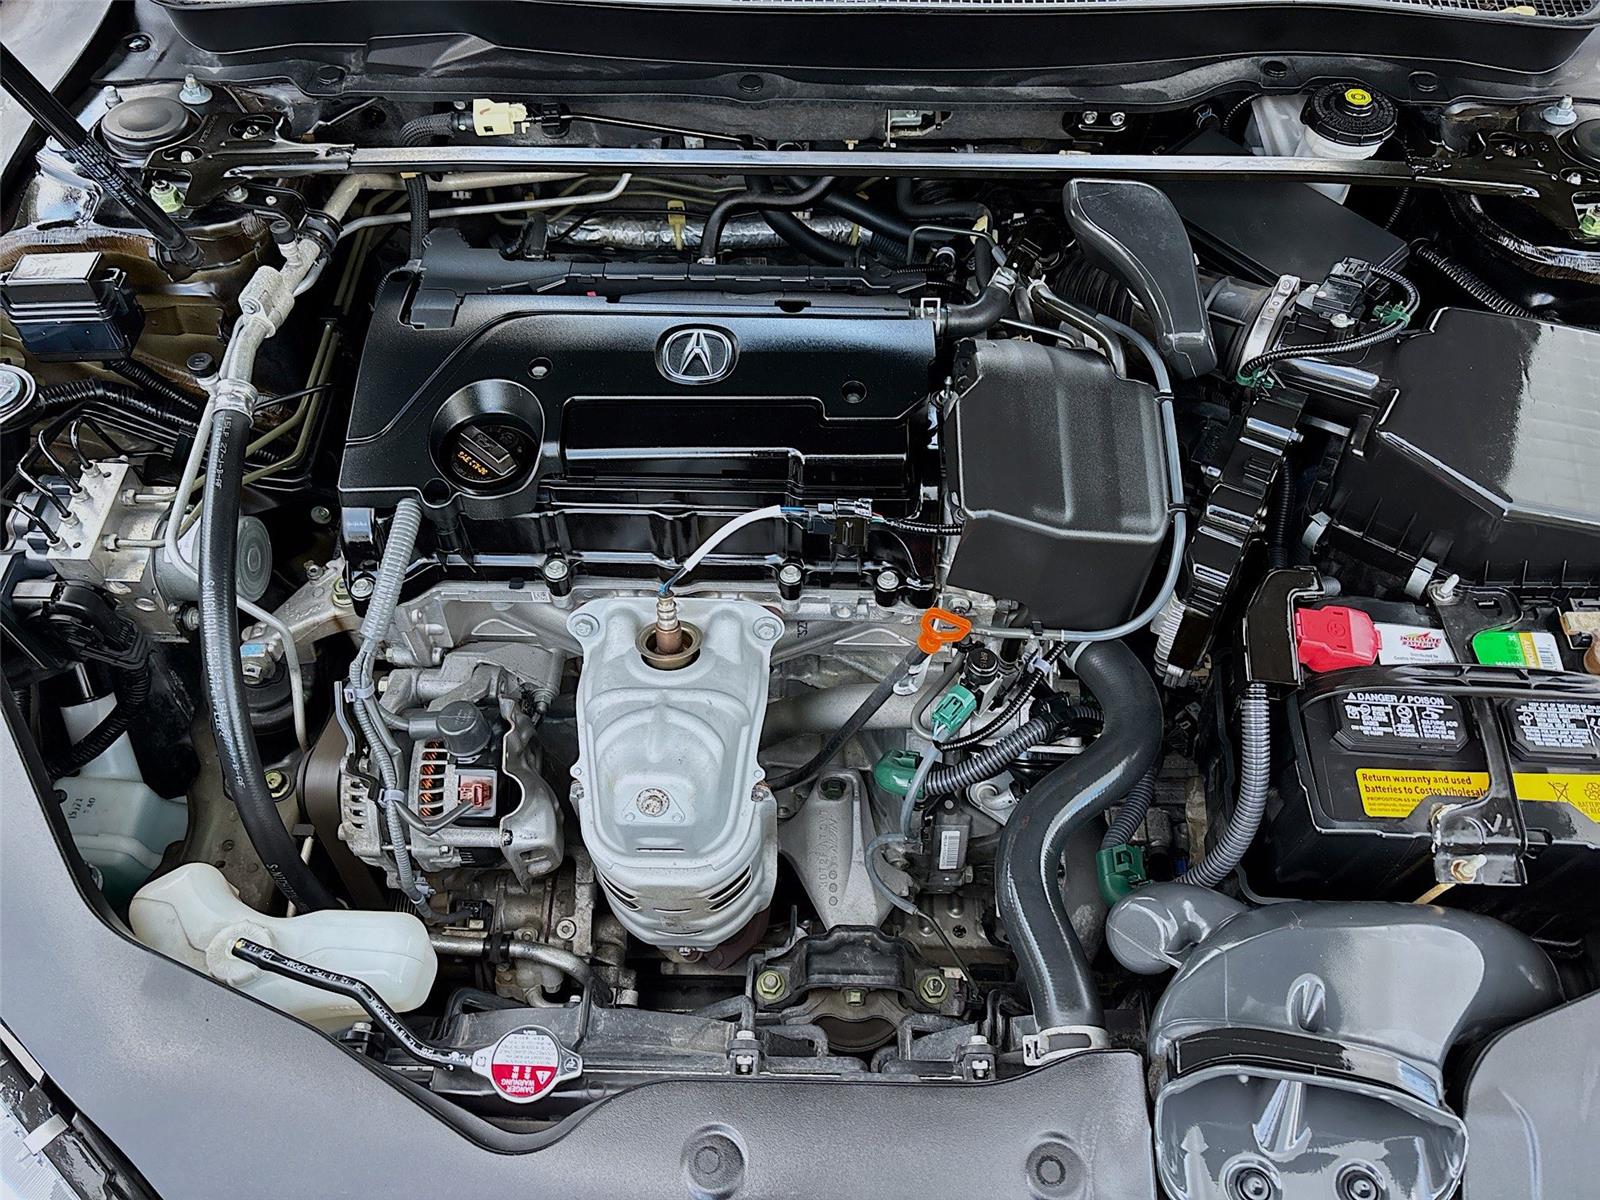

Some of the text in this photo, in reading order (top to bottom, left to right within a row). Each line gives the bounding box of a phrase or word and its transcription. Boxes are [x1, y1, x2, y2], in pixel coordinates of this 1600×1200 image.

[1357, 693, 1398, 703] DANGER
[1407, 695, 1445, 705] POISON
[1362, 773, 1472, 785] Return warranty and used
[1365, 784, 1402, 794] batteries
[1404, 786, 1413, 794] to
[1414, 786, 1441, 795] Costco
[506, 1086, 535, 1094] DANGER
